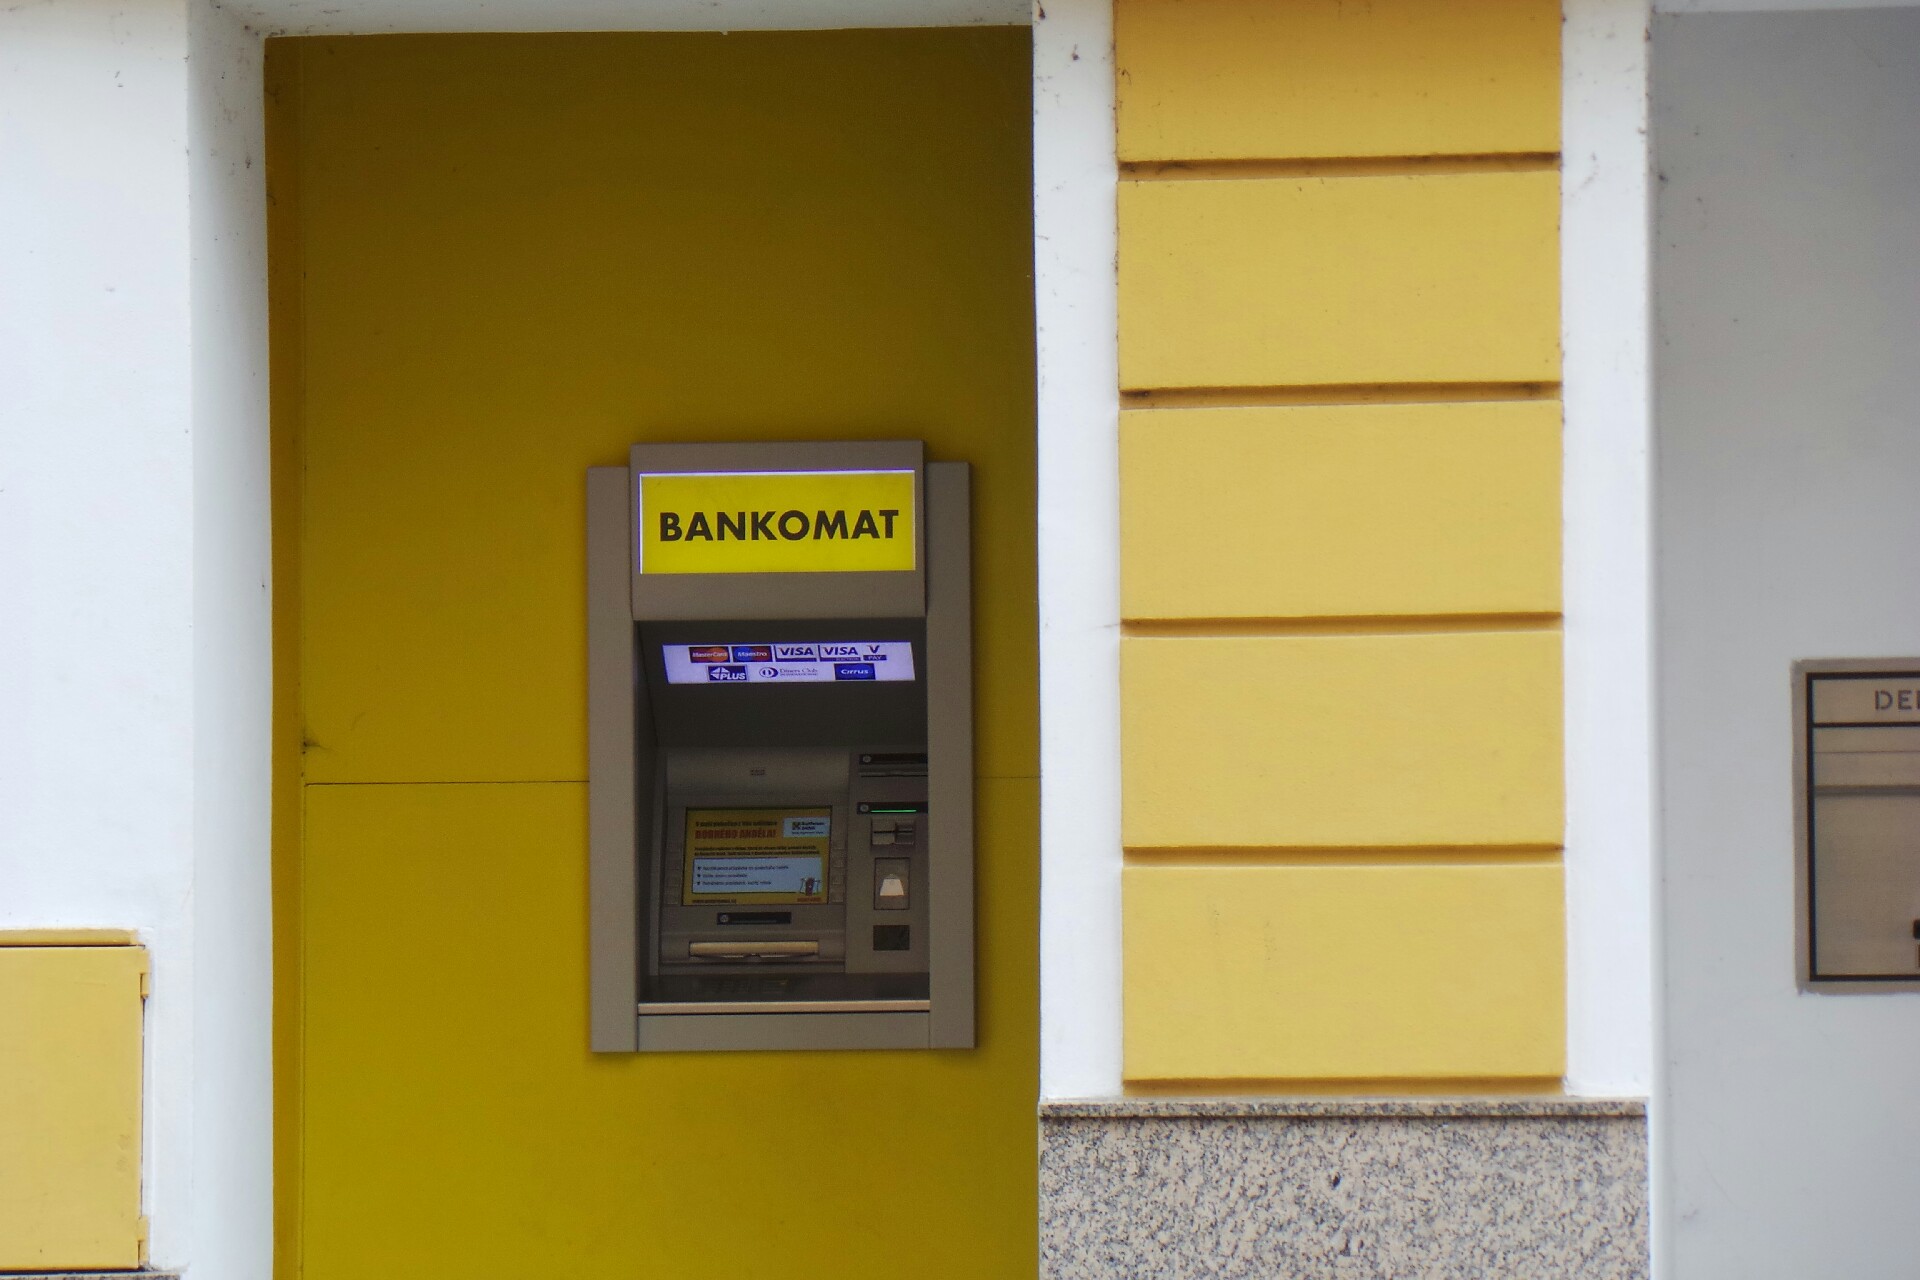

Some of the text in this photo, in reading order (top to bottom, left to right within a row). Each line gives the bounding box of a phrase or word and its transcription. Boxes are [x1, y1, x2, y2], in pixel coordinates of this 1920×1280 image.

[660, 509, 900, 542] BANKOMAT
[779, 647, 814, 656] VISA
[824, 646, 859, 656] VISA
[869, 645, 880, 654] V
[720, 672, 746, 680] PLUS
[1874, 689, 1920, 710] DE
